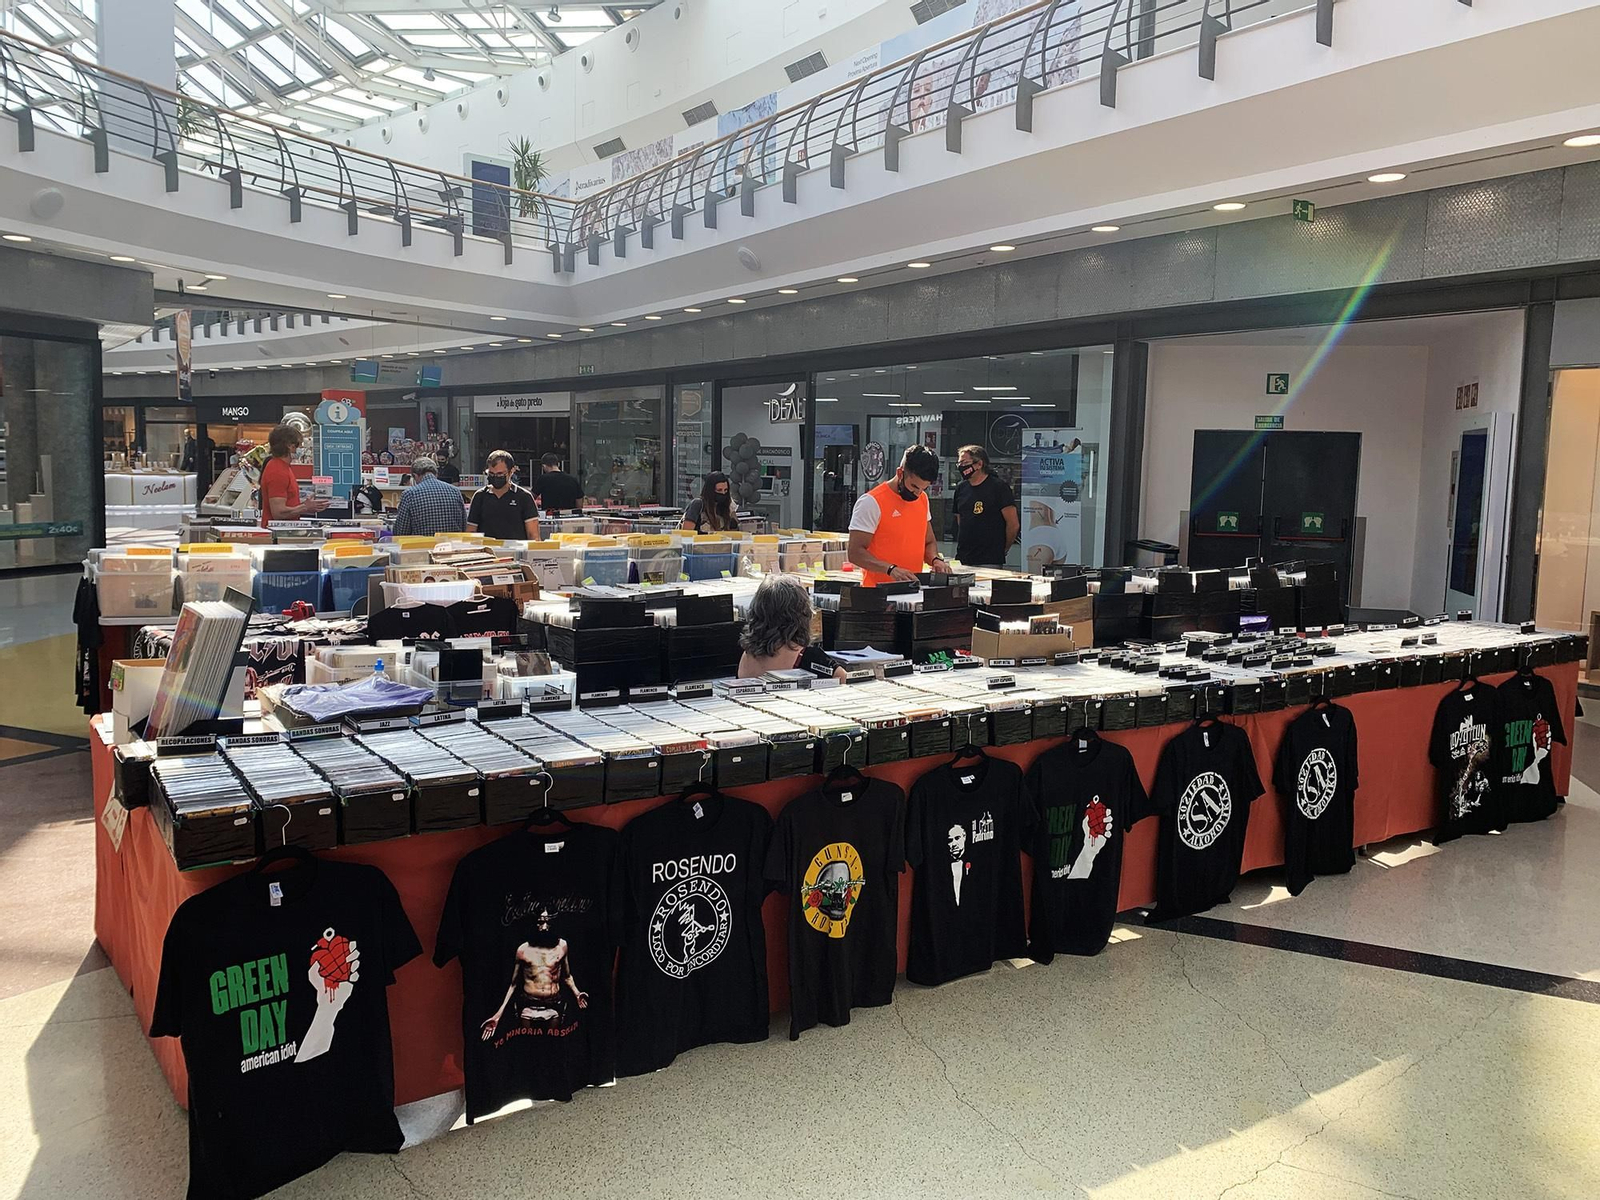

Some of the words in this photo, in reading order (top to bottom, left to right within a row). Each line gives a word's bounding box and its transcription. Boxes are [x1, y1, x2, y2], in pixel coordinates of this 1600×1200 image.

[222, 406, 249, 416] MANGO
[527, 397, 543, 410] preto
[1039, 458, 1065, 466] ACTIVA
[142, 480, 176, 496] Neelam
[684, 683, 704, 691] FLAMENCO
[434, 713, 451, 722] LATINA
[291, 728, 313, 738] BANDAS
[314, 725, 340, 735] SONORAS
[160, 736, 212, 746] RECOPILACIONES
[227, 737, 250, 745] BANDAS
[251, 735, 278, 744] SONORAS
[1180, 775, 1215, 821] SOZIEDAD
[1188, 793, 1230, 847] ALKOHOLIKA
[971, 830, 994, 844] Padrino
[814, 845, 850, 868] GUNS
[652, 853, 737, 883] ROSENDO
[656, 879, 727, 919] ROSENDO
[652, 934, 665, 964] LOCO
[665, 960, 684, 976] POR
[687, 922, 728, 972] INCORDIAR
[209, 953, 289, 1015] GREEN
[240, 999, 287, 1055] DAY
[506, 1027, 543, 1040] MINORIA
[240, 1050, 280, 1074] american
[280, 1040, 297, 1061] idiot
